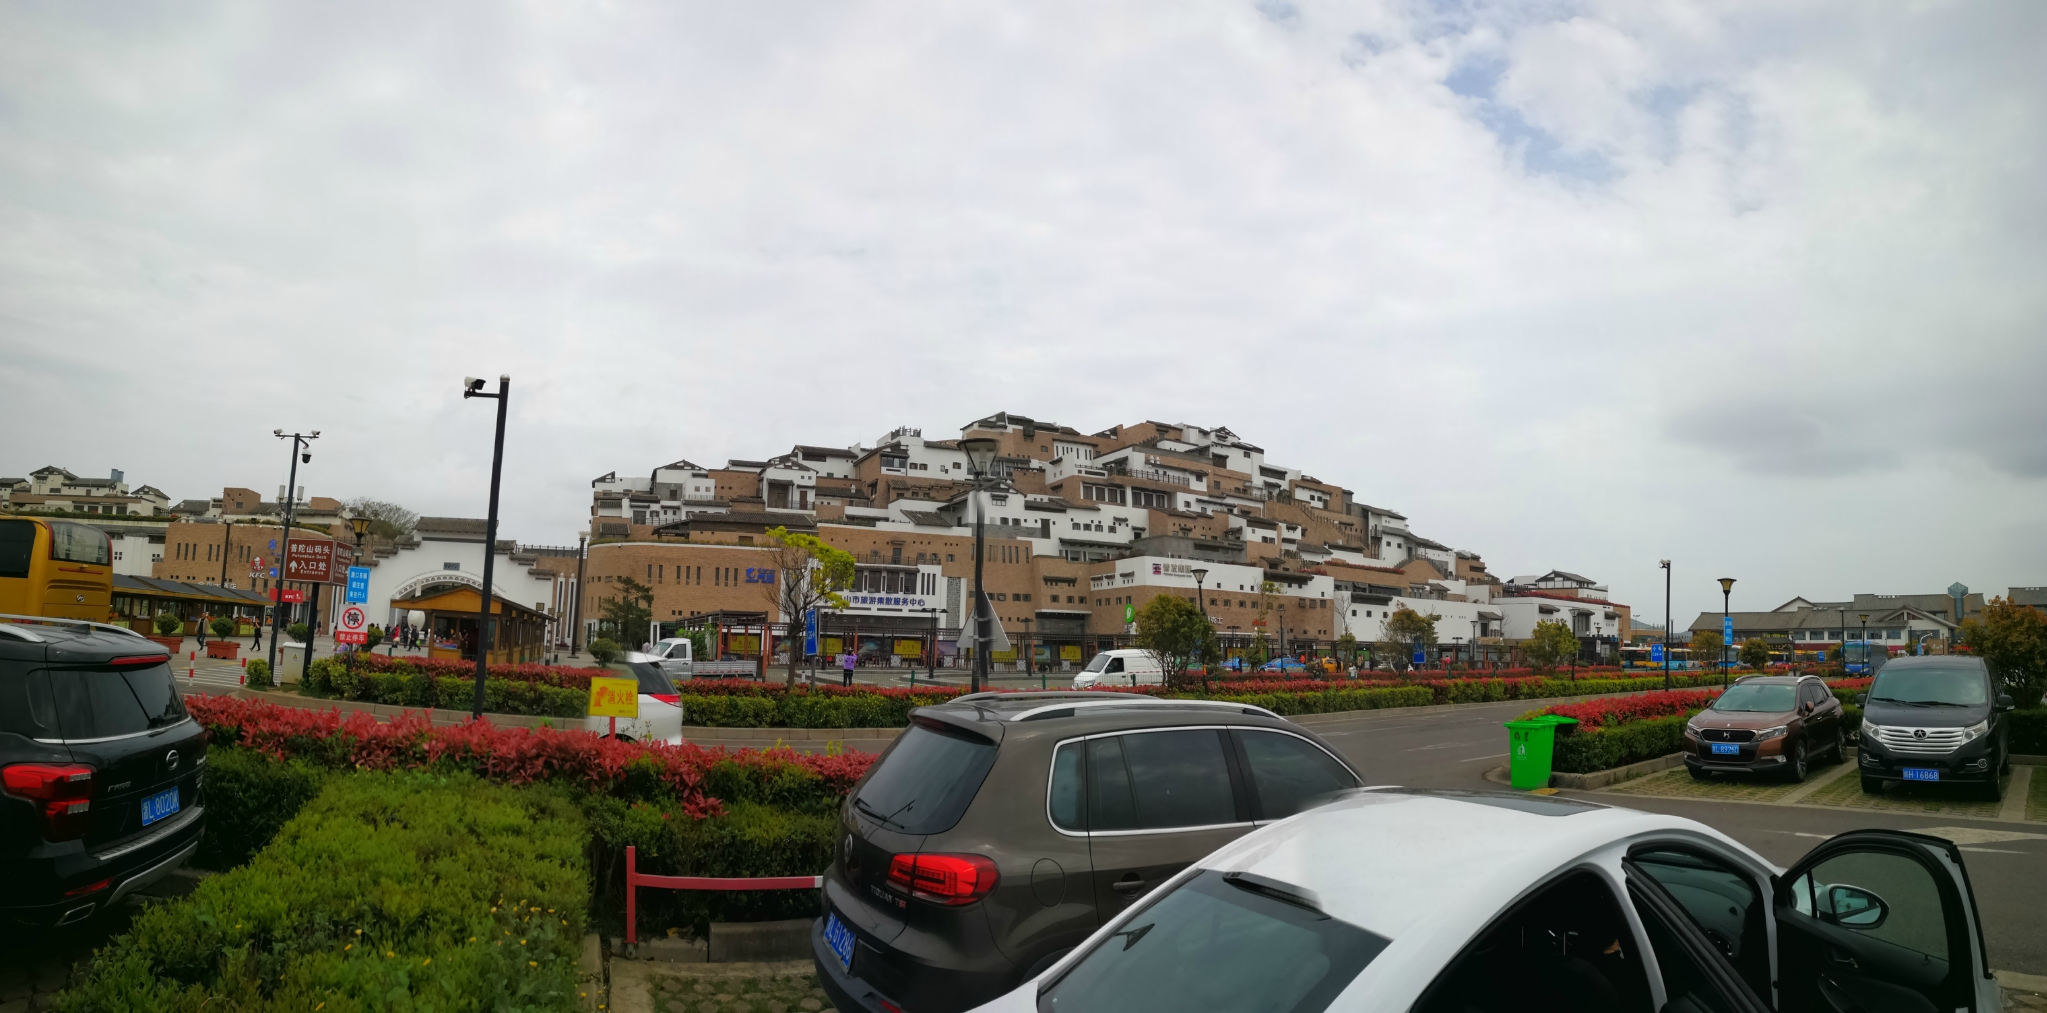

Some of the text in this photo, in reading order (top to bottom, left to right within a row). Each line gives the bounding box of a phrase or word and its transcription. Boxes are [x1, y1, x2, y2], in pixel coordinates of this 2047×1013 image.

[290, 543, 331, 554] 普陀山码头
[298, 560, 327, 571] 入口处
[347, 611, 360, 625] 停
[339, 633, 365, 642] 禁止停车
[608, 690, 634, 705] 消火栓
[870, 884, 893, 904] TIGUAN
